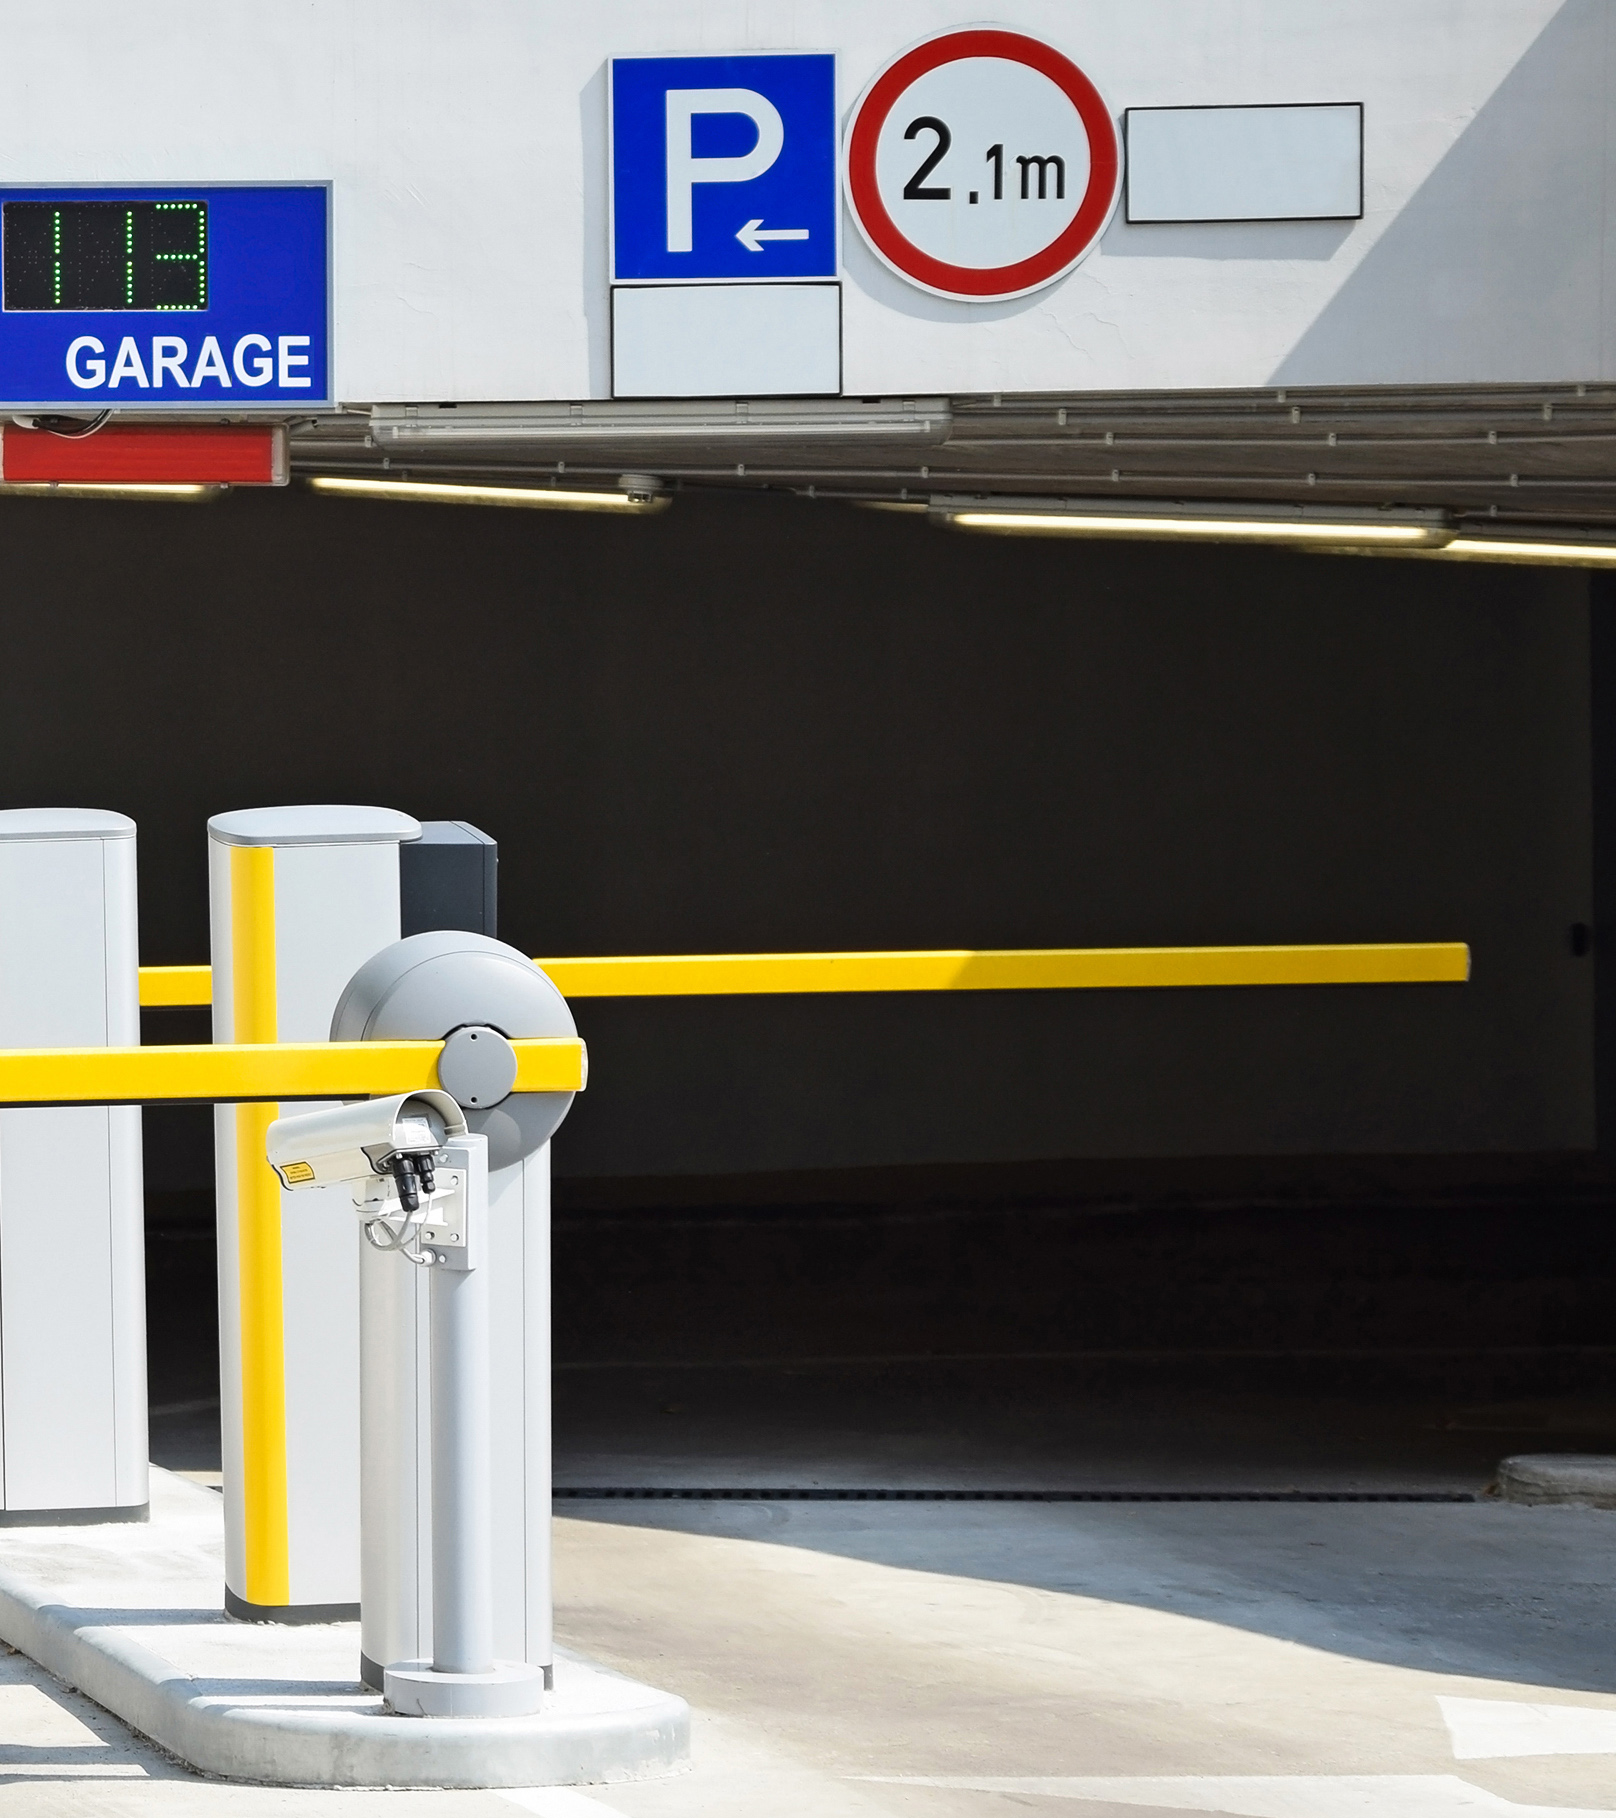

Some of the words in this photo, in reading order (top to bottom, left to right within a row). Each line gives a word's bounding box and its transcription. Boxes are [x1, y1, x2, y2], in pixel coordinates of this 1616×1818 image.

[666, 88, 784, 253] P
[54, 204, 205, 309] 113
[65, 333, 312, 390] GARAGE
